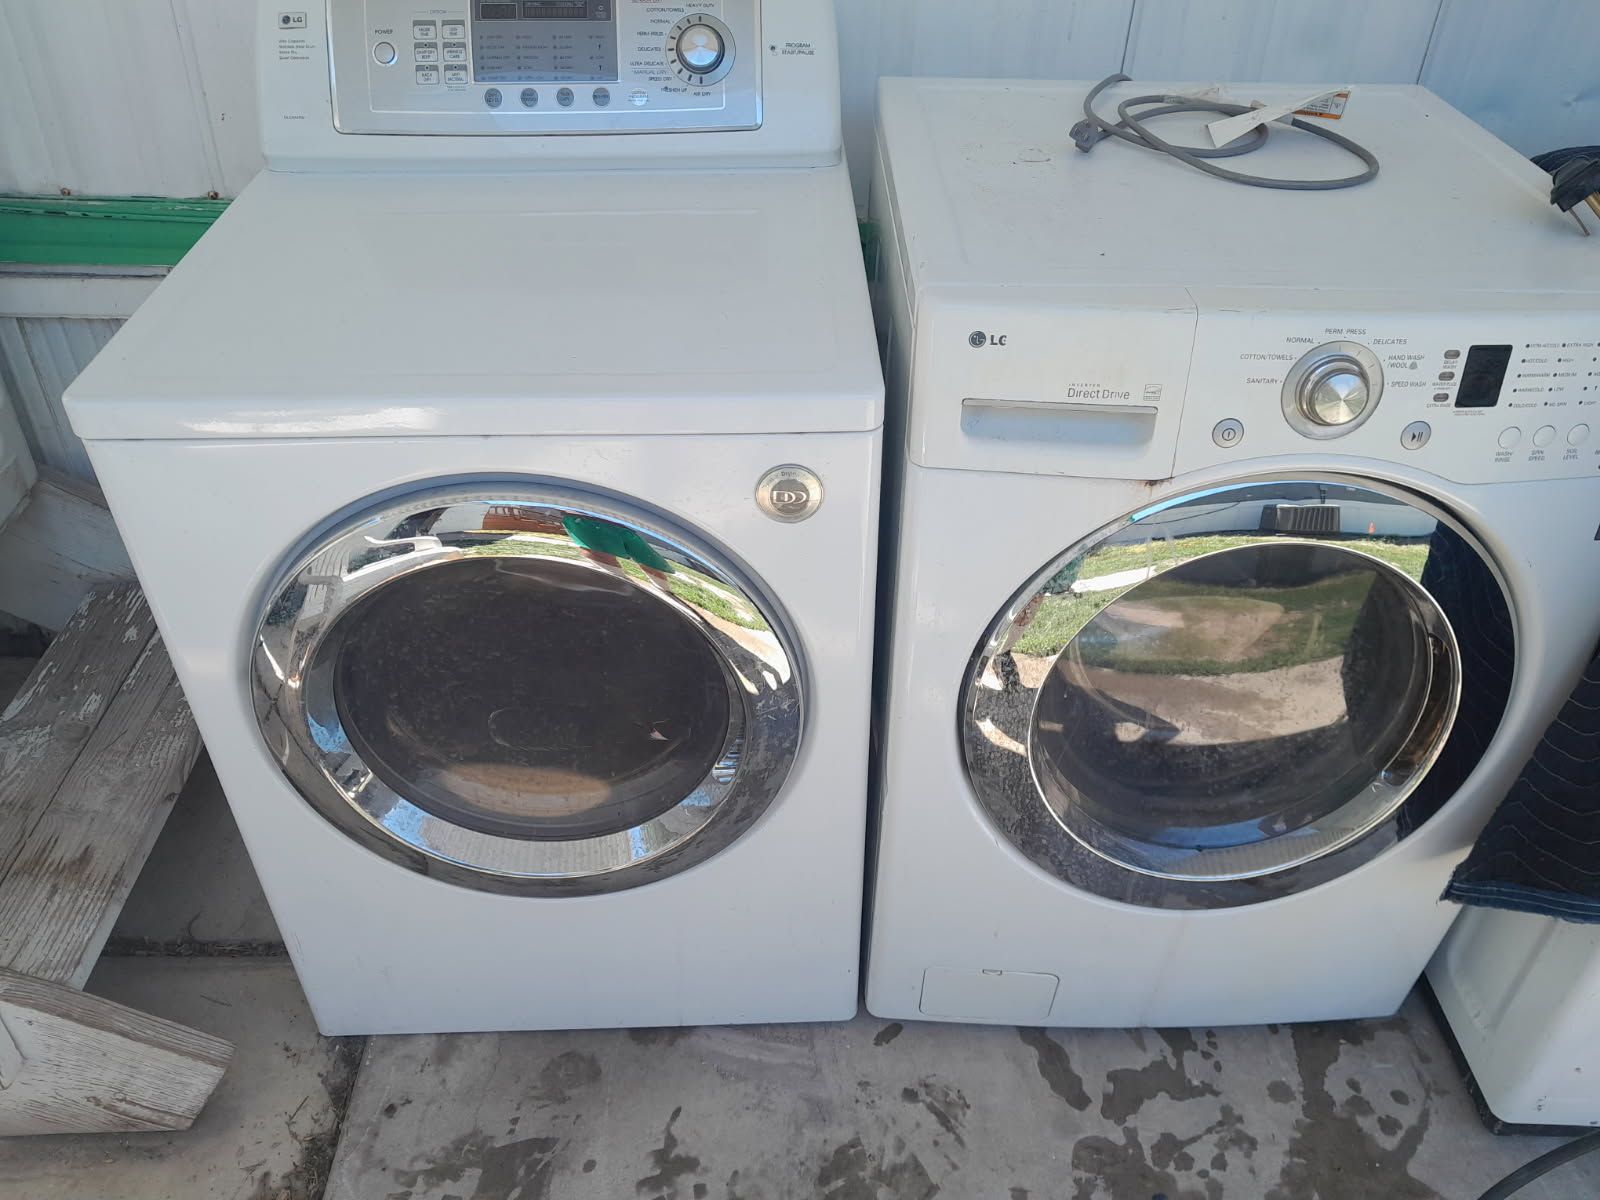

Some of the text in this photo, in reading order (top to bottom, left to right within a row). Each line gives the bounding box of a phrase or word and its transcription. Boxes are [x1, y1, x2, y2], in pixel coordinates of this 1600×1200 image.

[989, 334, 1007, 346] LG
[1240, 353, 1293, 361] COTTON/TOWELS
[1067, 387, 1100, 399] Direct
[1102, 389, 1130, 400] Drive
